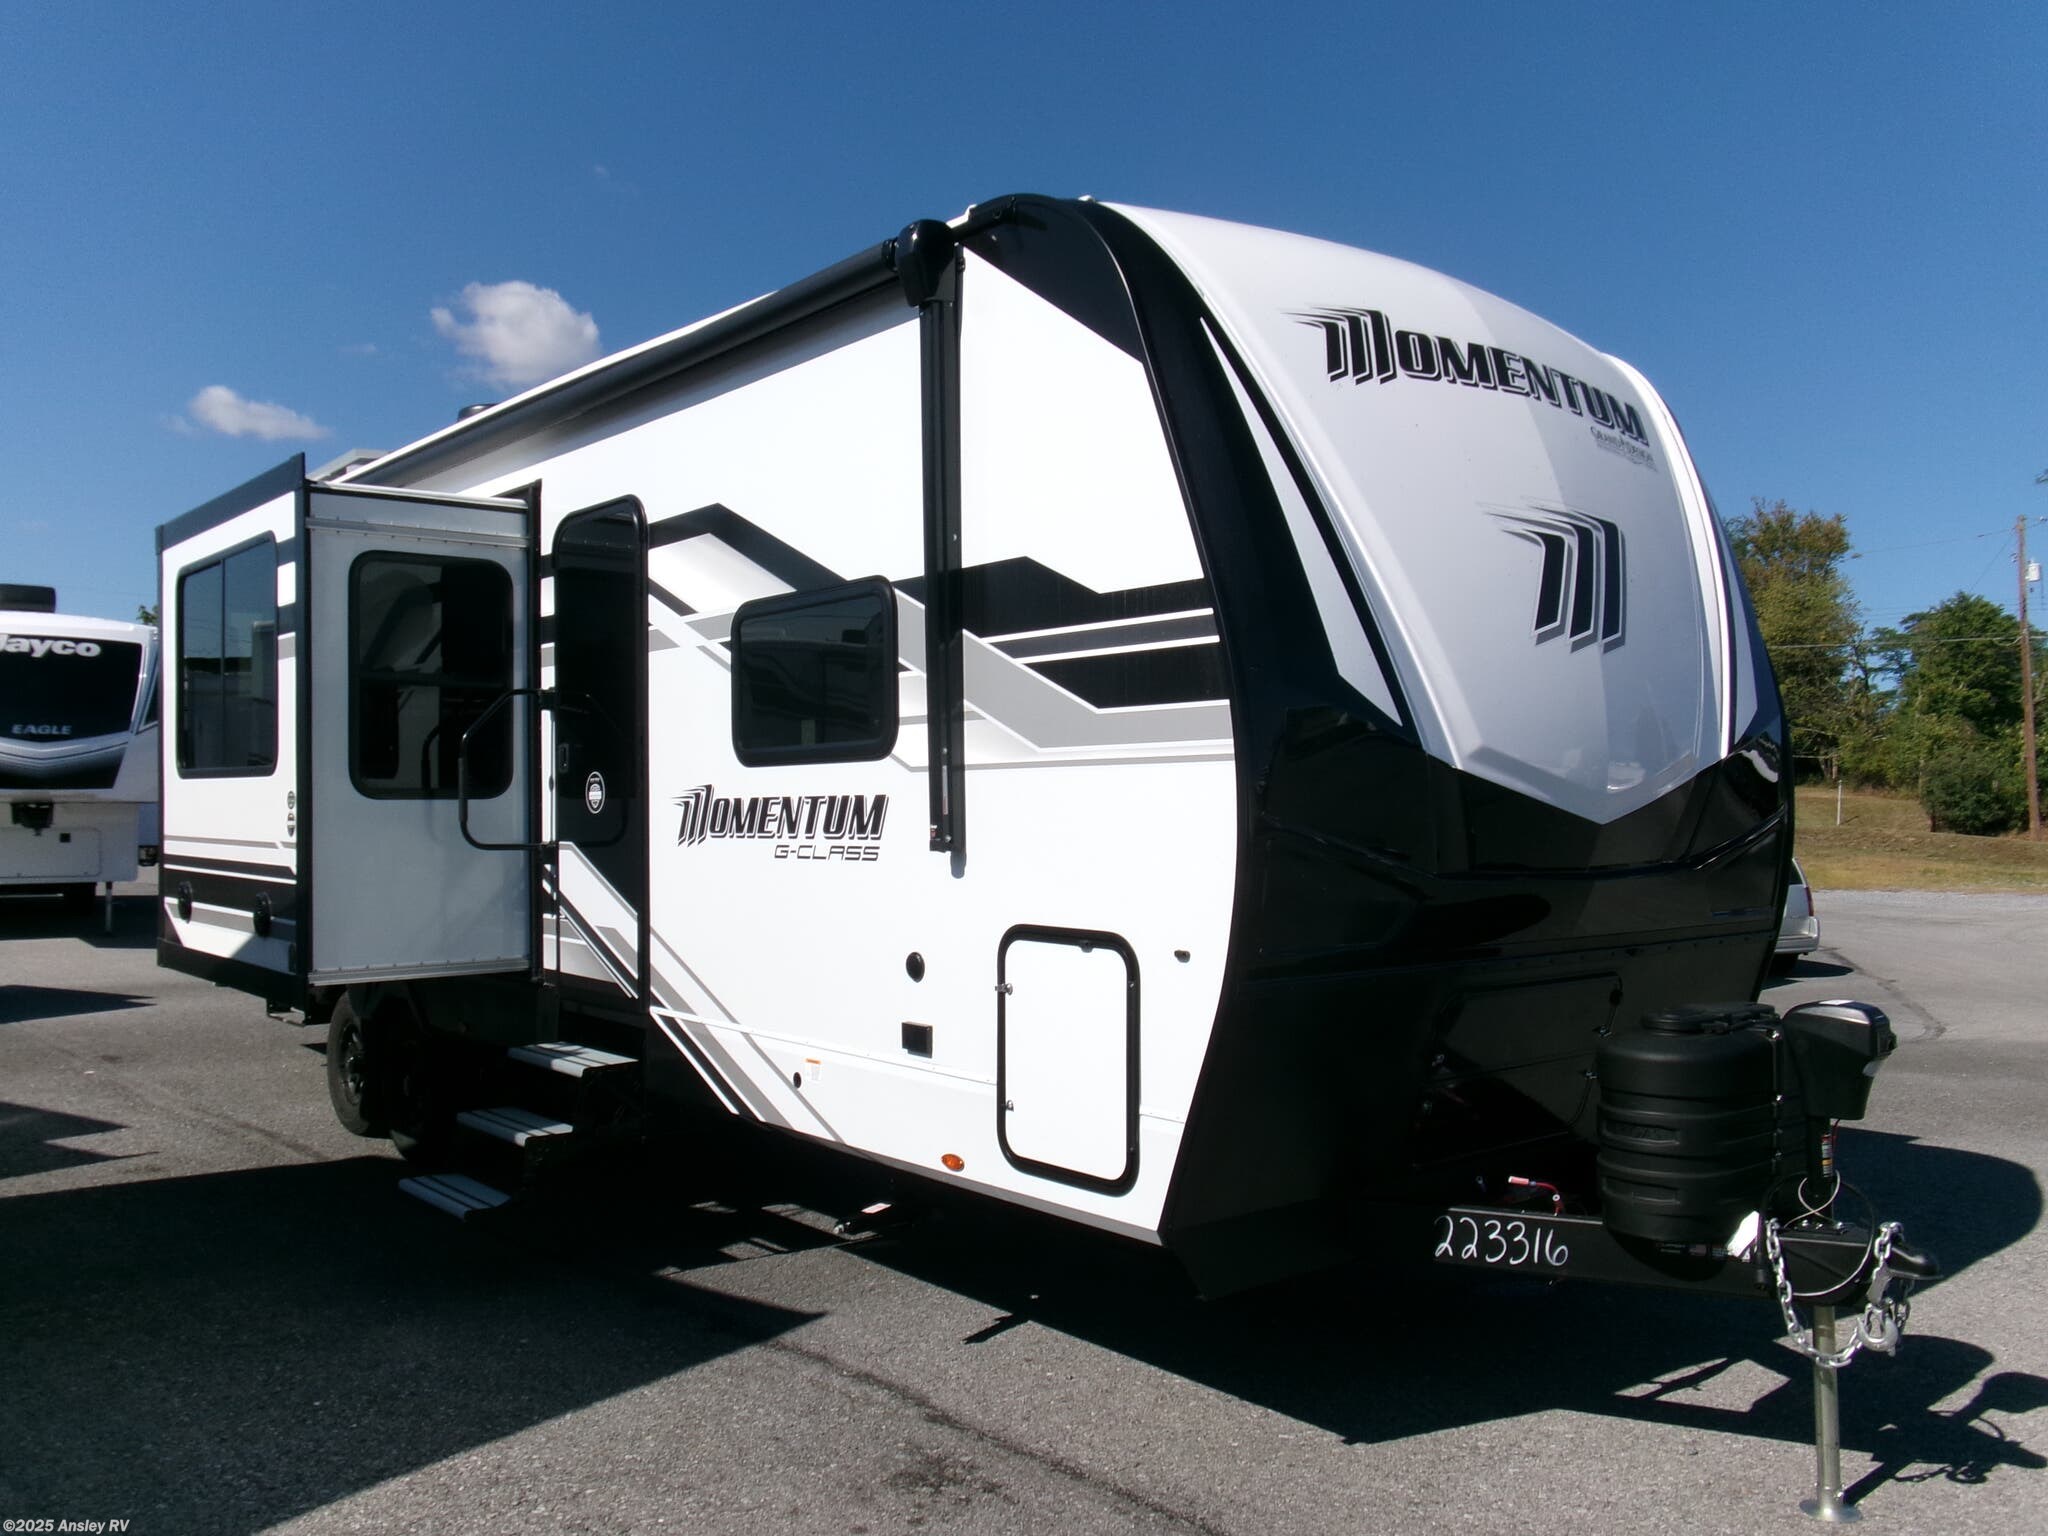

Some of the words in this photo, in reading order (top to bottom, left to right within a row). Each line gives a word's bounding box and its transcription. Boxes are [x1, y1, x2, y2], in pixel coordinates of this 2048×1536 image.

[1284, 306, 1650, 447] MOMENTUM
[11, 723, 72, 735] EAGLE
[673, 784, 889, 847] MOMENTUM
[774, 844, 880, 861] G-CLASS
[1434, 1215, 1568, 1266] 223316
